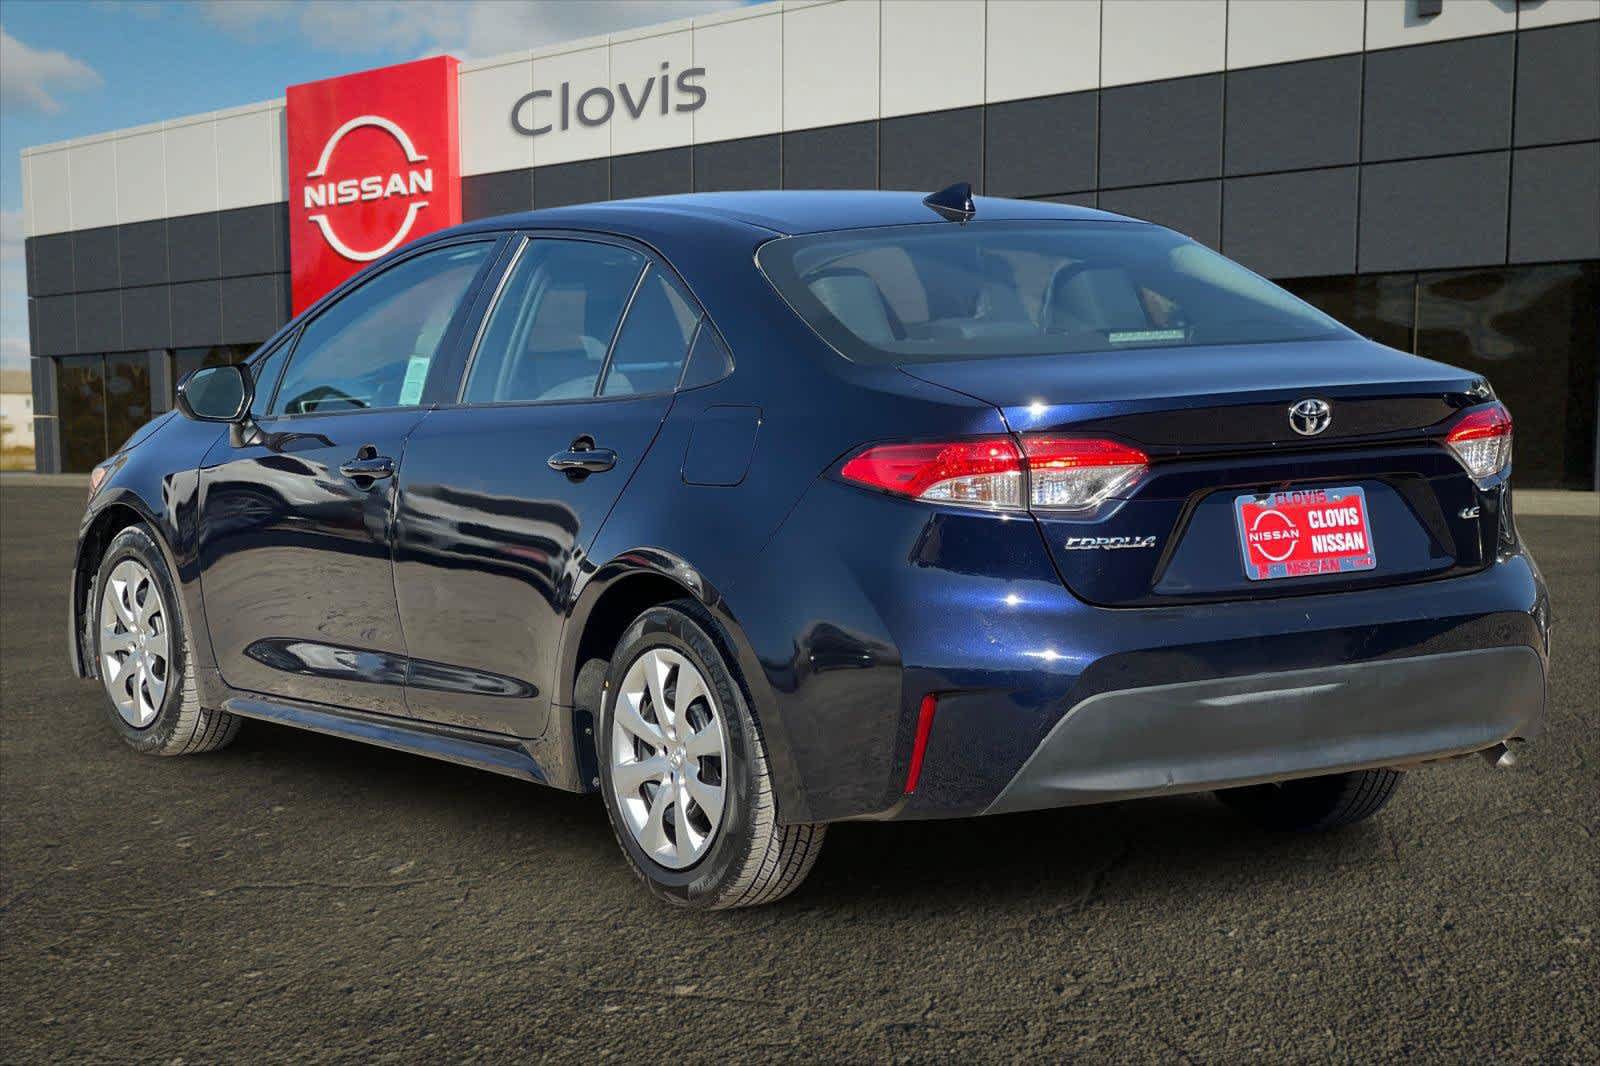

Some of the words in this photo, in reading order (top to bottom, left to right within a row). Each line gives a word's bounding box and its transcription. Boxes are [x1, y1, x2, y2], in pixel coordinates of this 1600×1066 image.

[511, 62, 707, 136] Clovis
[304, 168, 433, 208] NISSAN
[1308, 507, 1359, 529] CLOVIS
[1064, 536, 1156, 550] COROLLA
[1249, 529, 1299, 543] NISSAN
[1311, 531, 1365, 554] NISSAN
